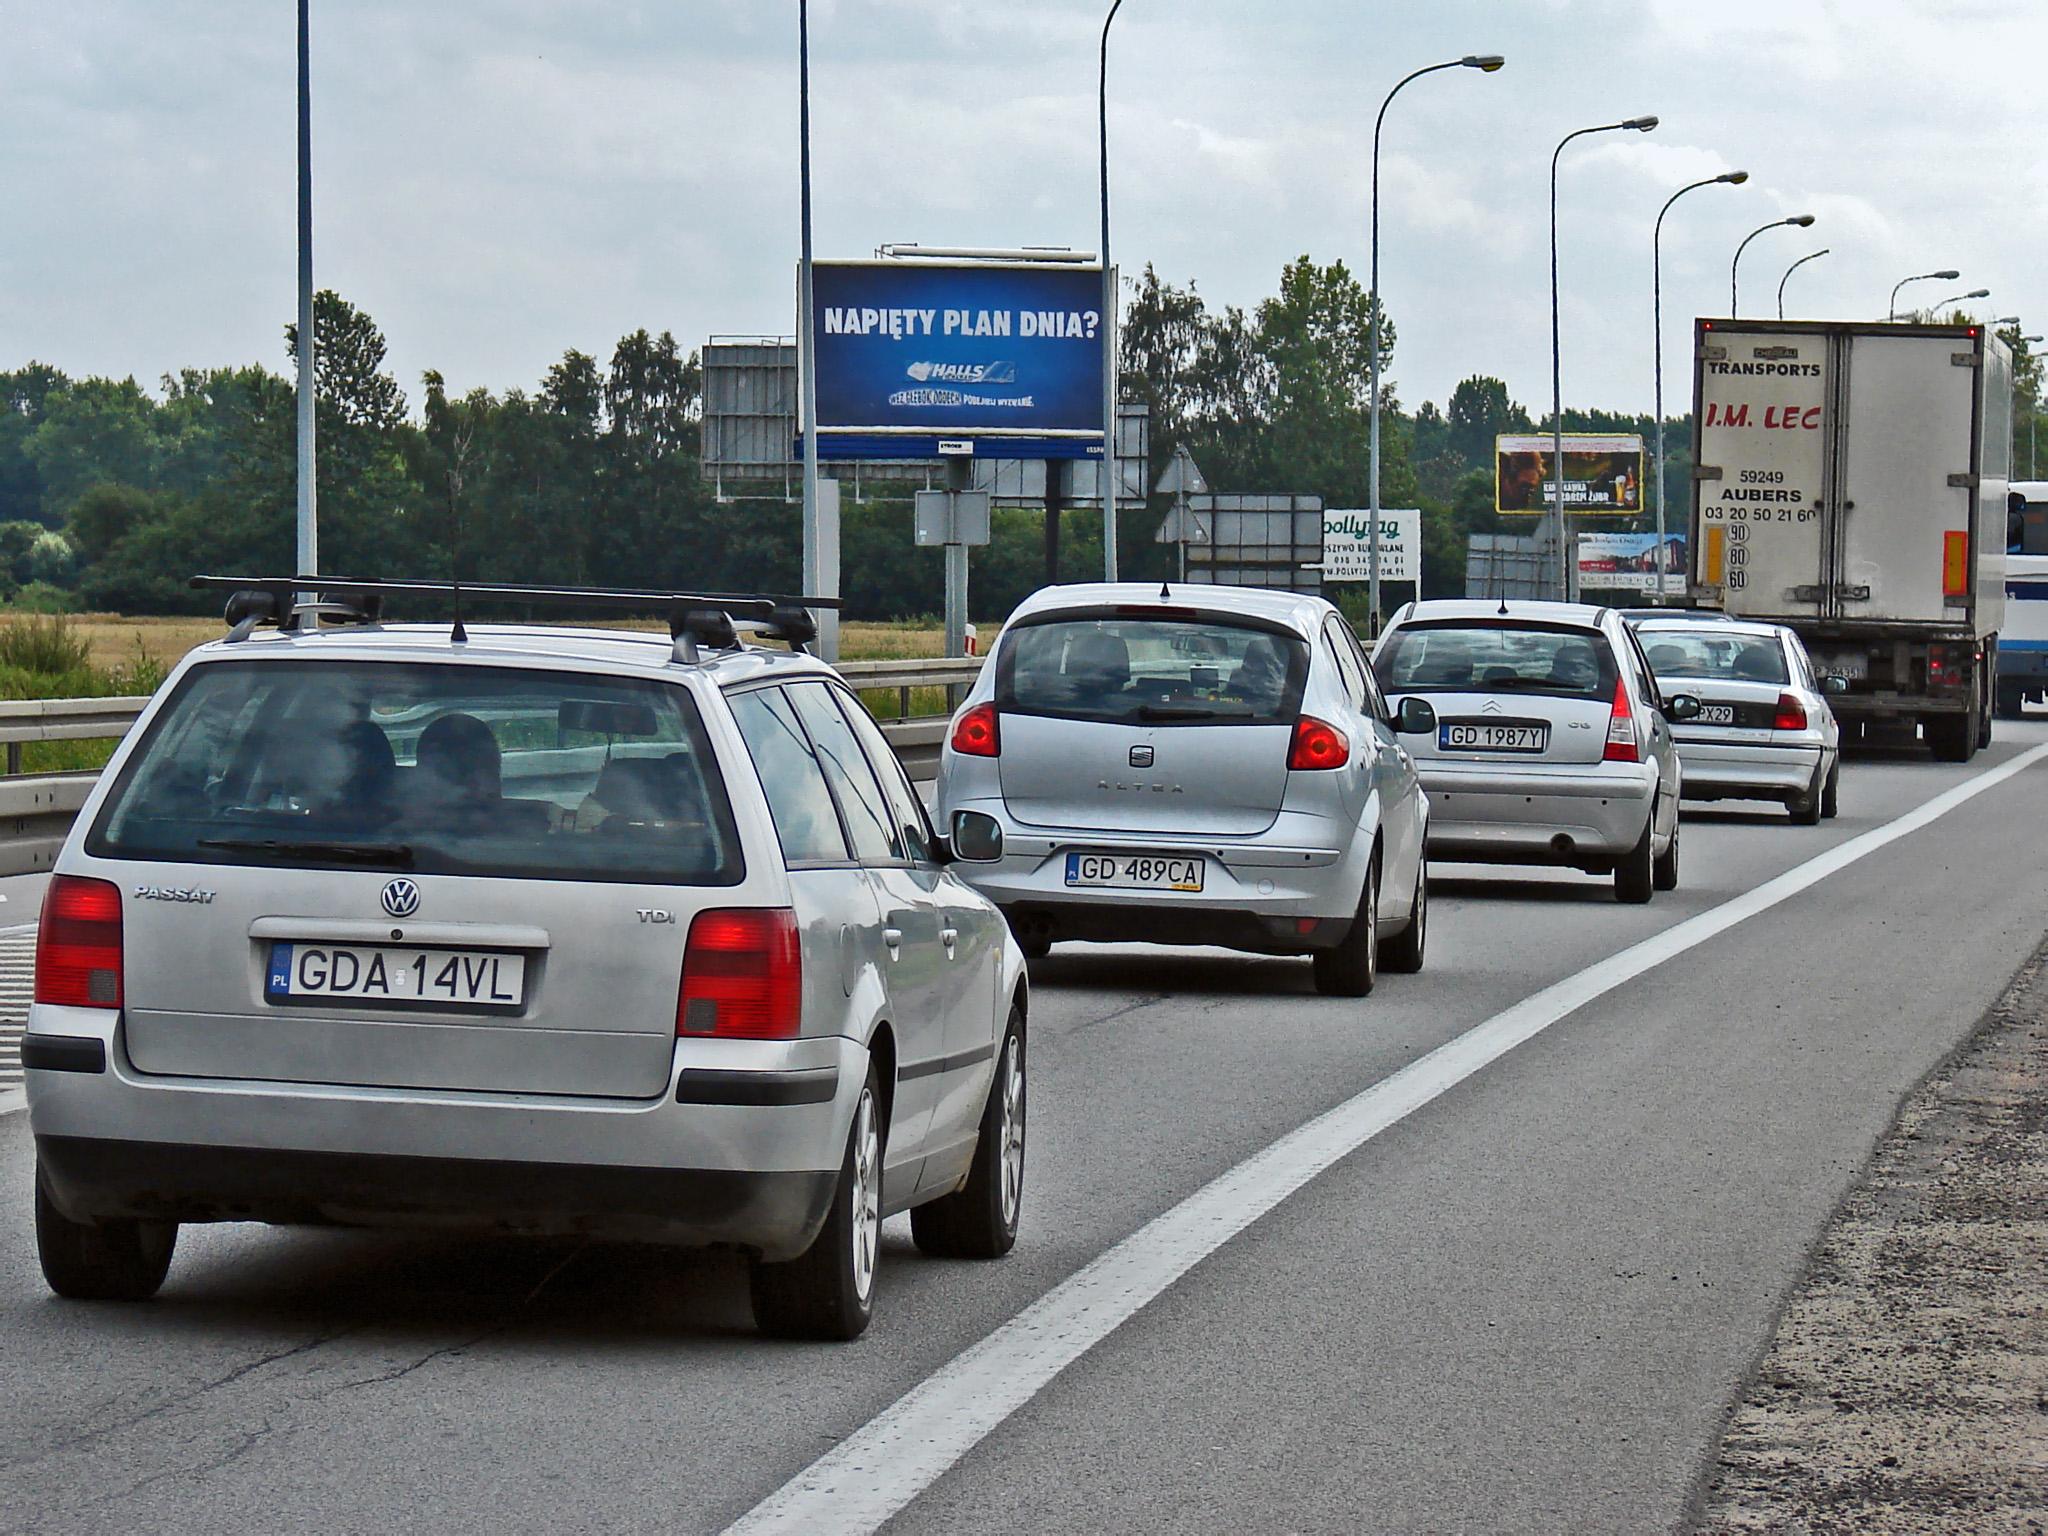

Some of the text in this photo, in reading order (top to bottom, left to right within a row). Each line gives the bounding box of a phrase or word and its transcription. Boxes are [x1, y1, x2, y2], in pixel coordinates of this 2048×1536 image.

[824, 307, 1100, 340] NAPIĘTY PLAN DNIA?
[931, 363, 985, 378] HALLS
[1708, 362, 1821, 376] TRANSPORTS
[1763, 405, 1822, 430] LEC
[1740, 470, 1784, 484] 59249
[1721, 488, 1803, 502] AUBERS
[1705, 506, 1816, 523] 03 20 50 21 60
[1731, 525, 1746, 541] 90
[1730, 548, 1745, 565] 80
[1729, 571, 1745, 588] 60
[1452, 727, 1477, 744] GD
[1485, 728, 1541, 747] 1987Y
[1097, 779, 1184, 793] ALTEA
[1082, 857, 1116, 880] GD
[1125, 858, 1197, 884] 489CA
[134, 885, 217, 904] PASSAT
[636, 908, 676, 925] TDI
[272, 949, 513, 1001] PL GDA 14VL
